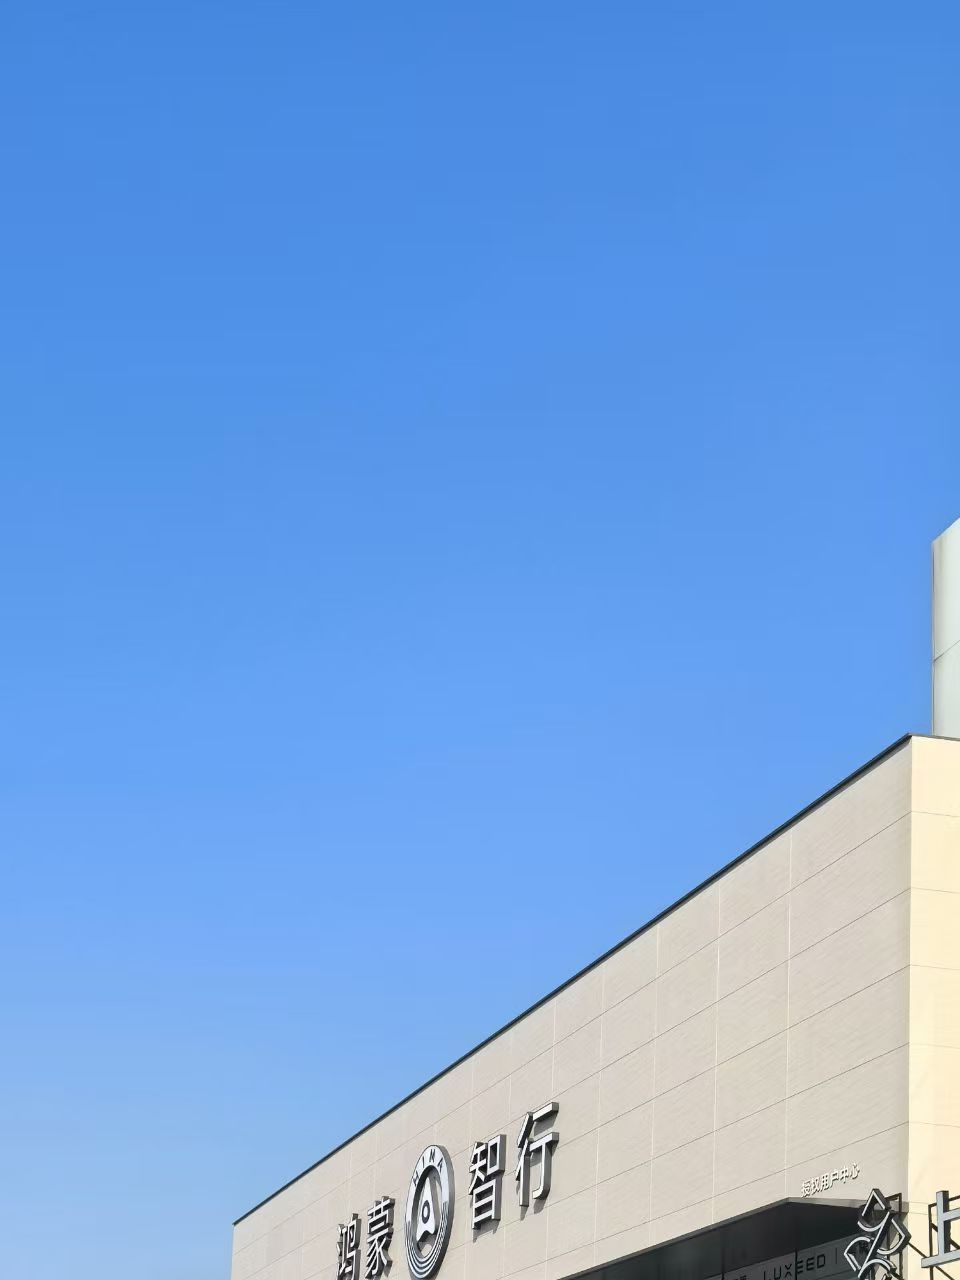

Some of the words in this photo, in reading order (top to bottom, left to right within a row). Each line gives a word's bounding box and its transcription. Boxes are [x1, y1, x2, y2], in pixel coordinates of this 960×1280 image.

[468, 1101, 560, 1231] 智行
[800, 1162, 861, 1198] 授权用户中心
